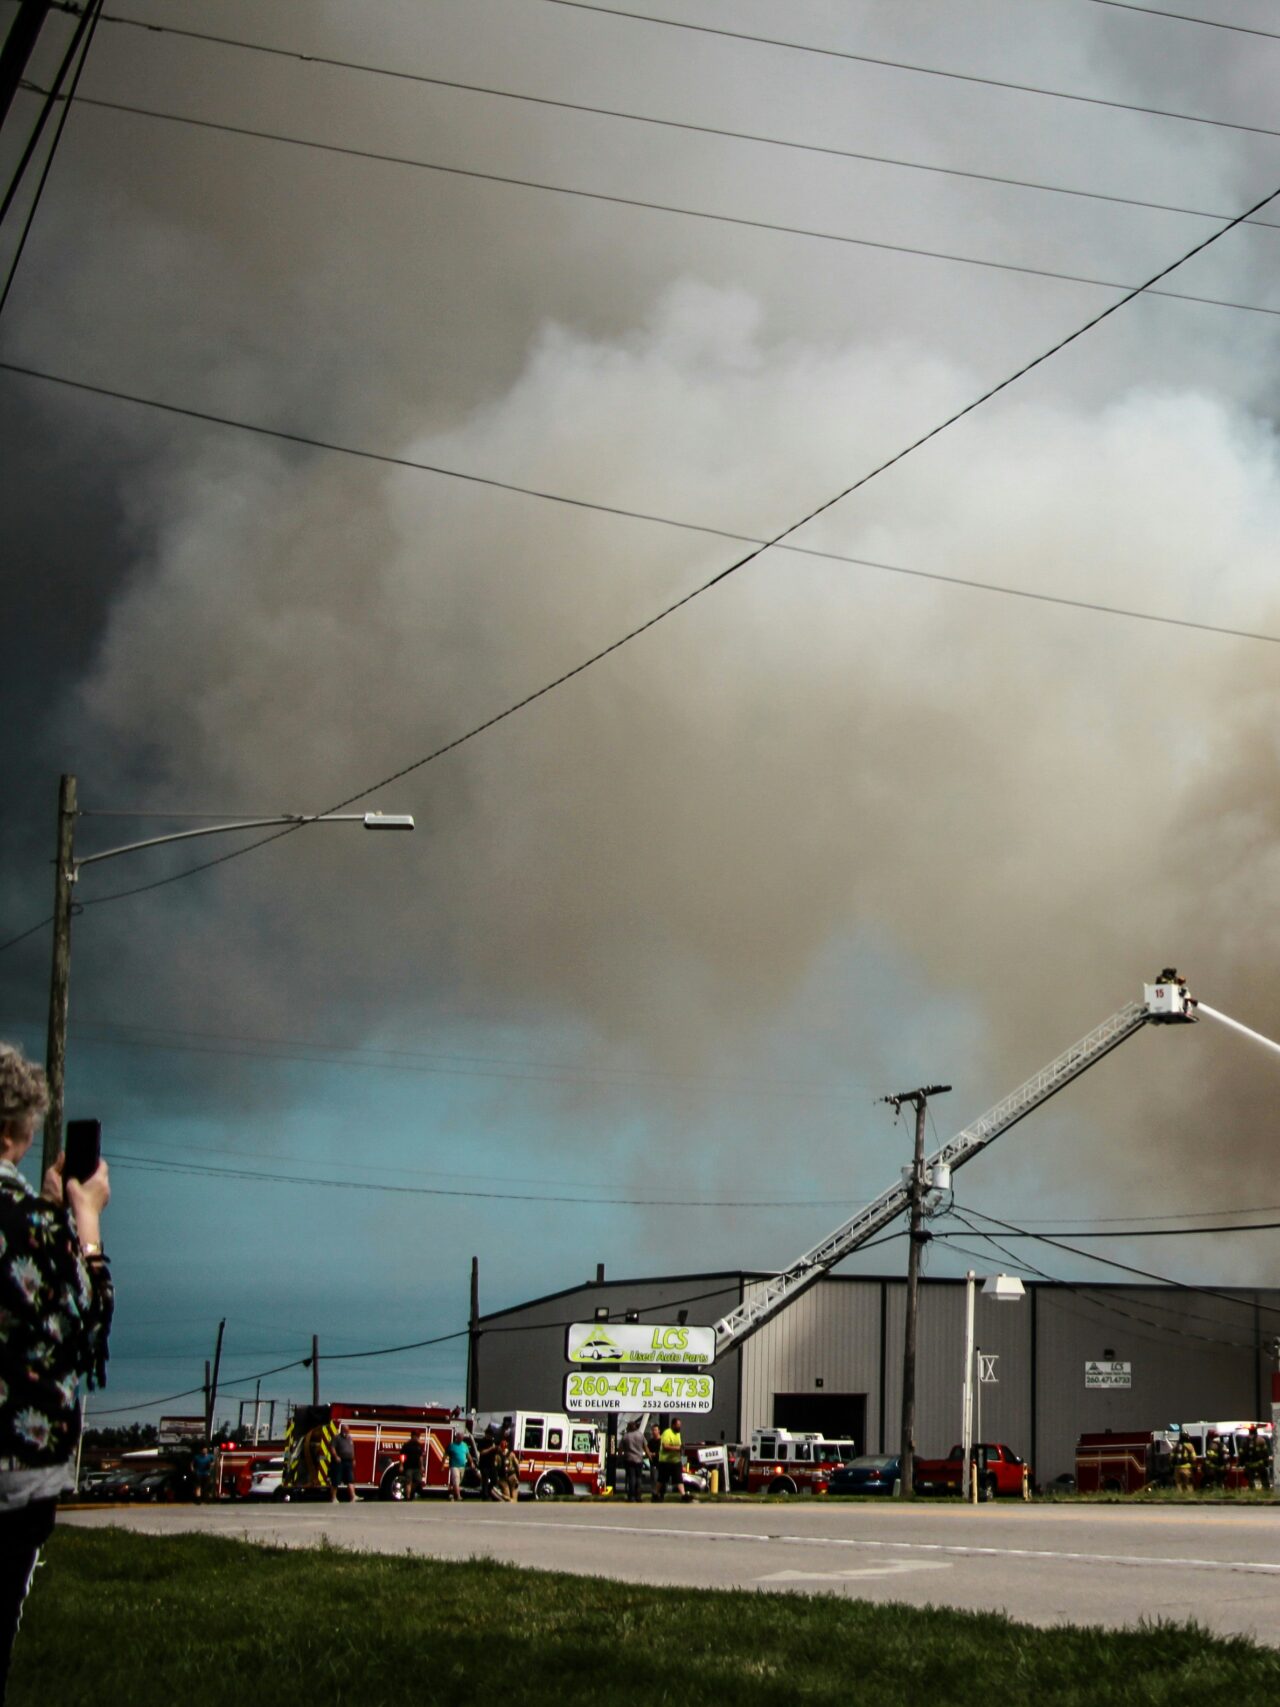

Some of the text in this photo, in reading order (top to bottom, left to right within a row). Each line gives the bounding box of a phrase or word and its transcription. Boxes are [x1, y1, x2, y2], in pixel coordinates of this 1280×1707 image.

[651, 1327, 690, 1350] LCS
[629, 1350, 709, 1363] Used Auto Parts
[1111, 1363, 1124, 1371] LCS
[569, 1375, 711, 1398] 260-471-4733
[570, 1399, 710, 1409] WE DELIVER 2532 GOSHEN RD
[529, 1458, 535, 1473] 7
[762, 1466, 770, 1476] 15
